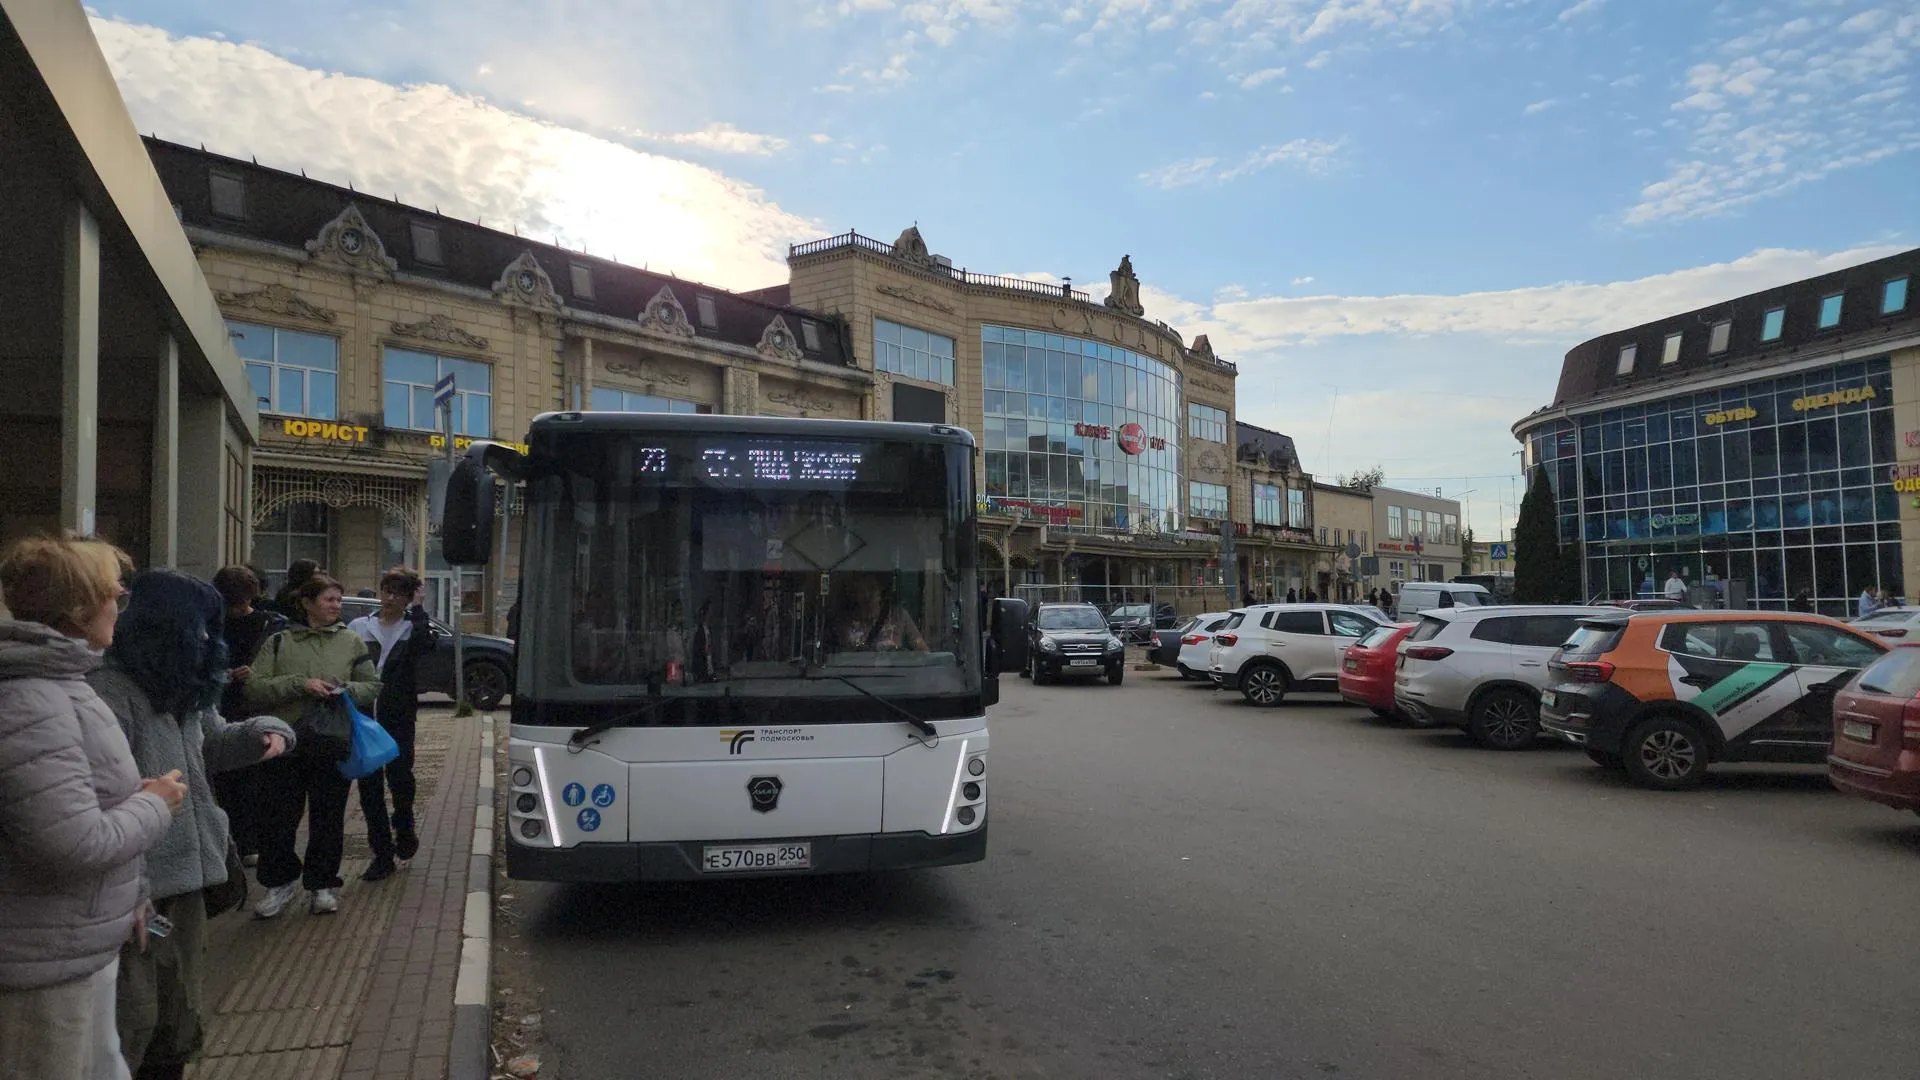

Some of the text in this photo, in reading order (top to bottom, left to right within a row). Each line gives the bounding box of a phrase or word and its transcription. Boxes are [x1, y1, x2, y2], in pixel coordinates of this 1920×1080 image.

[1791, 385, 1876, 412] ОДЕЖДА
[1705, 406, 1758, 426] ОБУВЬ
[283, 418, 368, 443] ЮРИСТ
[710, 847, 805, 868] Е570ВВ 250
